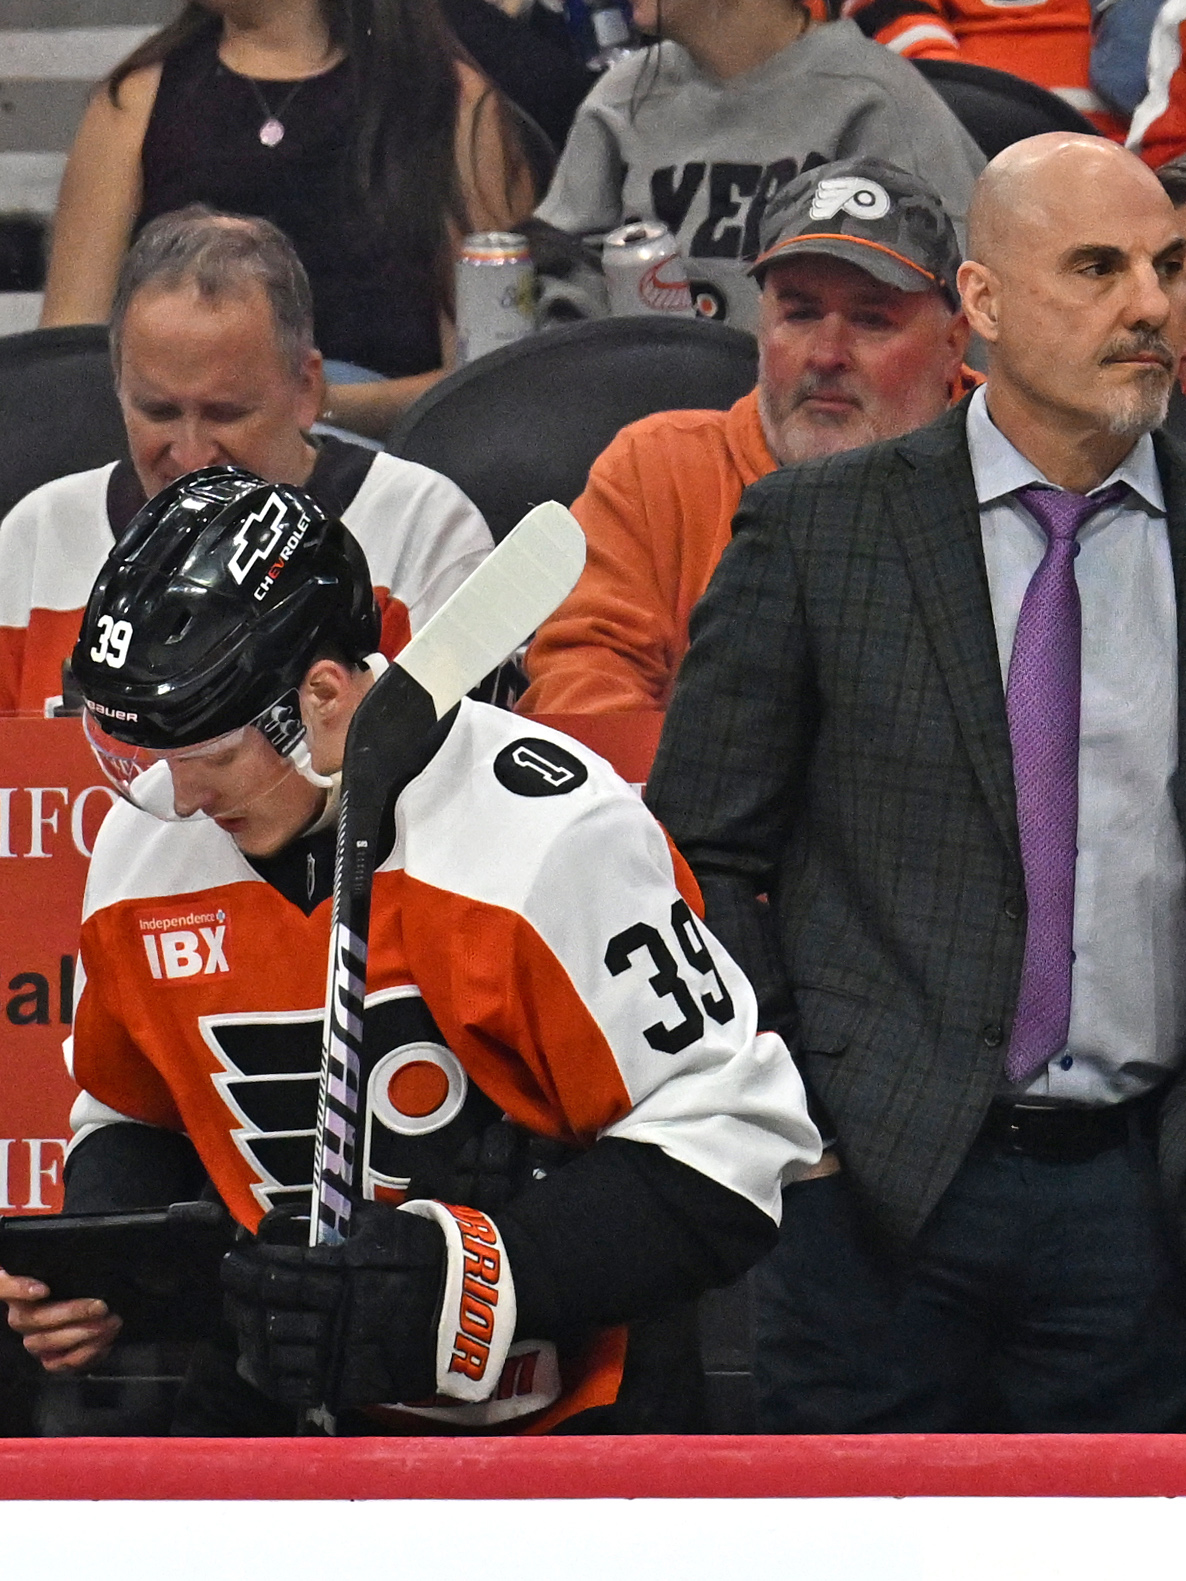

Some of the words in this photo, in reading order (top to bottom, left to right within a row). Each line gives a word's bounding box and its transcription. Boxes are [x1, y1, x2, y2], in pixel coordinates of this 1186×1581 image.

[254, 515, 312, 601] CHEVROLET
[90, 615, 133, 669] 39
[511, 746, 575, 787] 1
[139, 912, 215, 931] Independence
[142, 925, 229, 980] IBX
[604, 897, 735, 1055] 39
[447, 1203, 501, 1382] RRIOR
